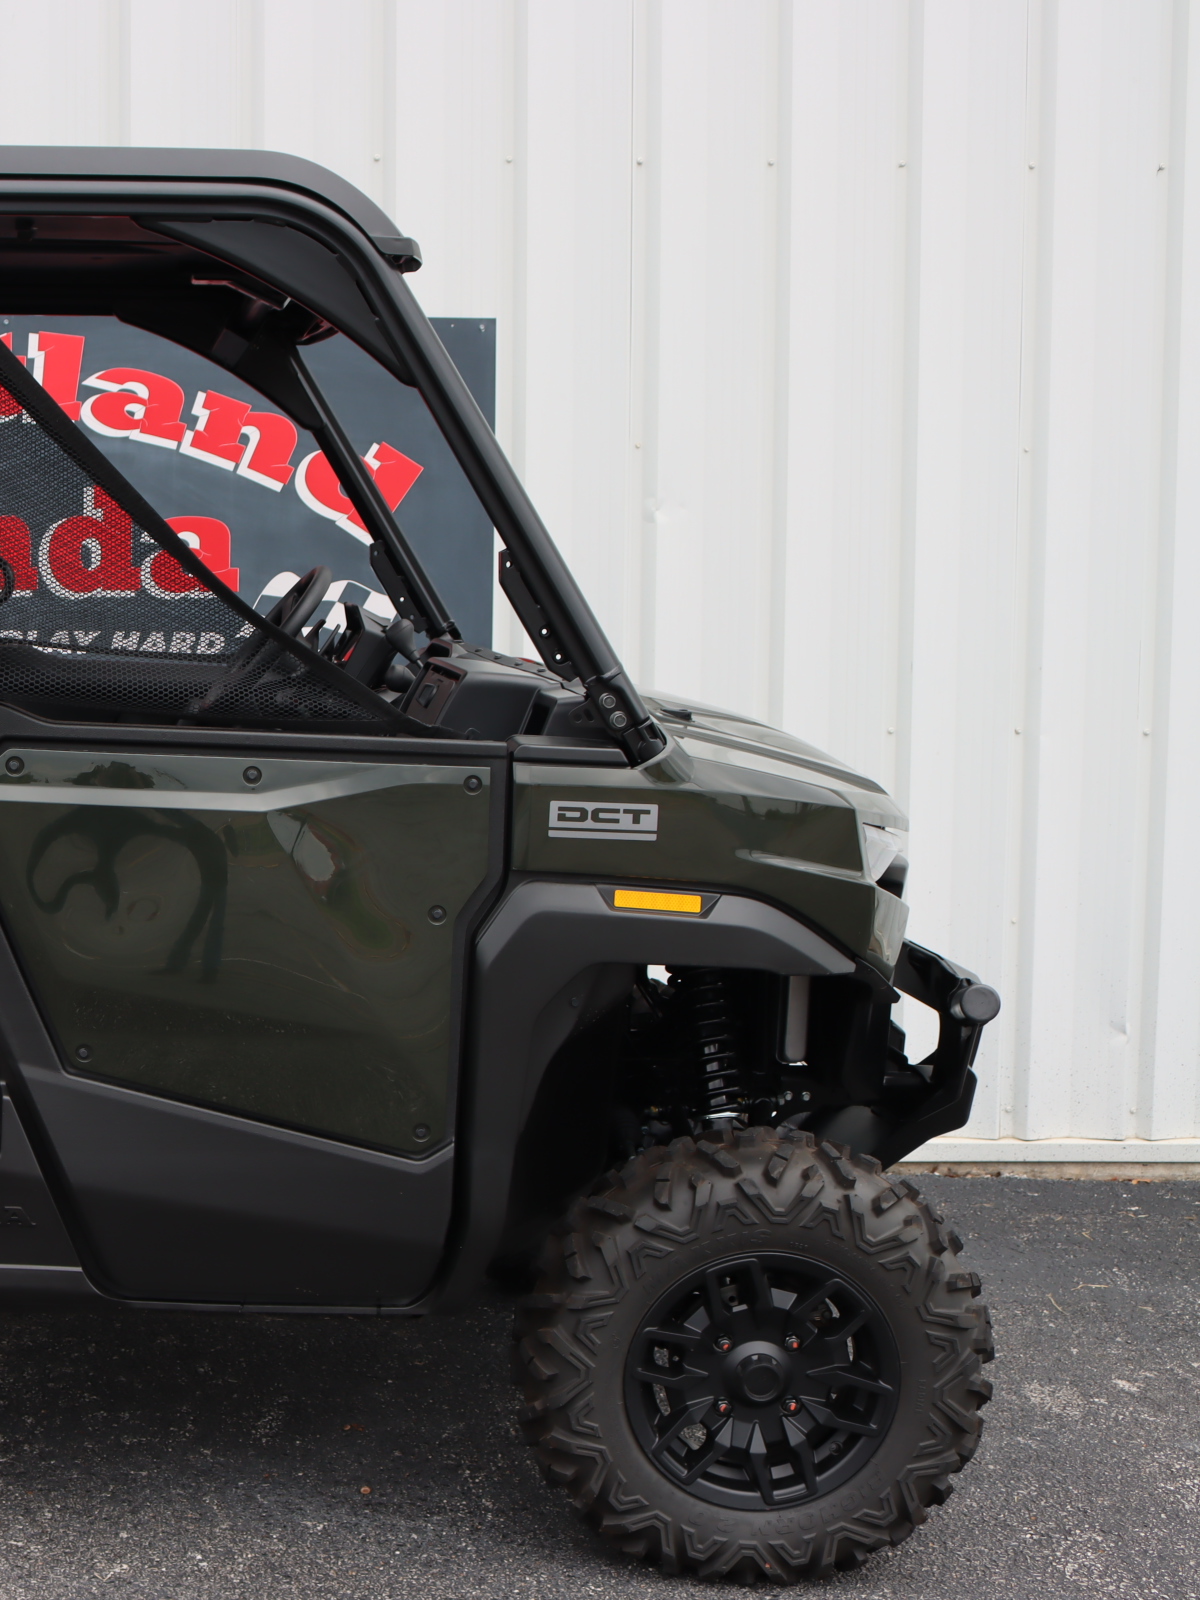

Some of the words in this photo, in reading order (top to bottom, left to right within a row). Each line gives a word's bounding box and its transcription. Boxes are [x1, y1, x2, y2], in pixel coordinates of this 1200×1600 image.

[111, 631, 226, 654] HARD
[557, 806, 652, 825] DCT
[688, 1511, 738, 1534] 20
